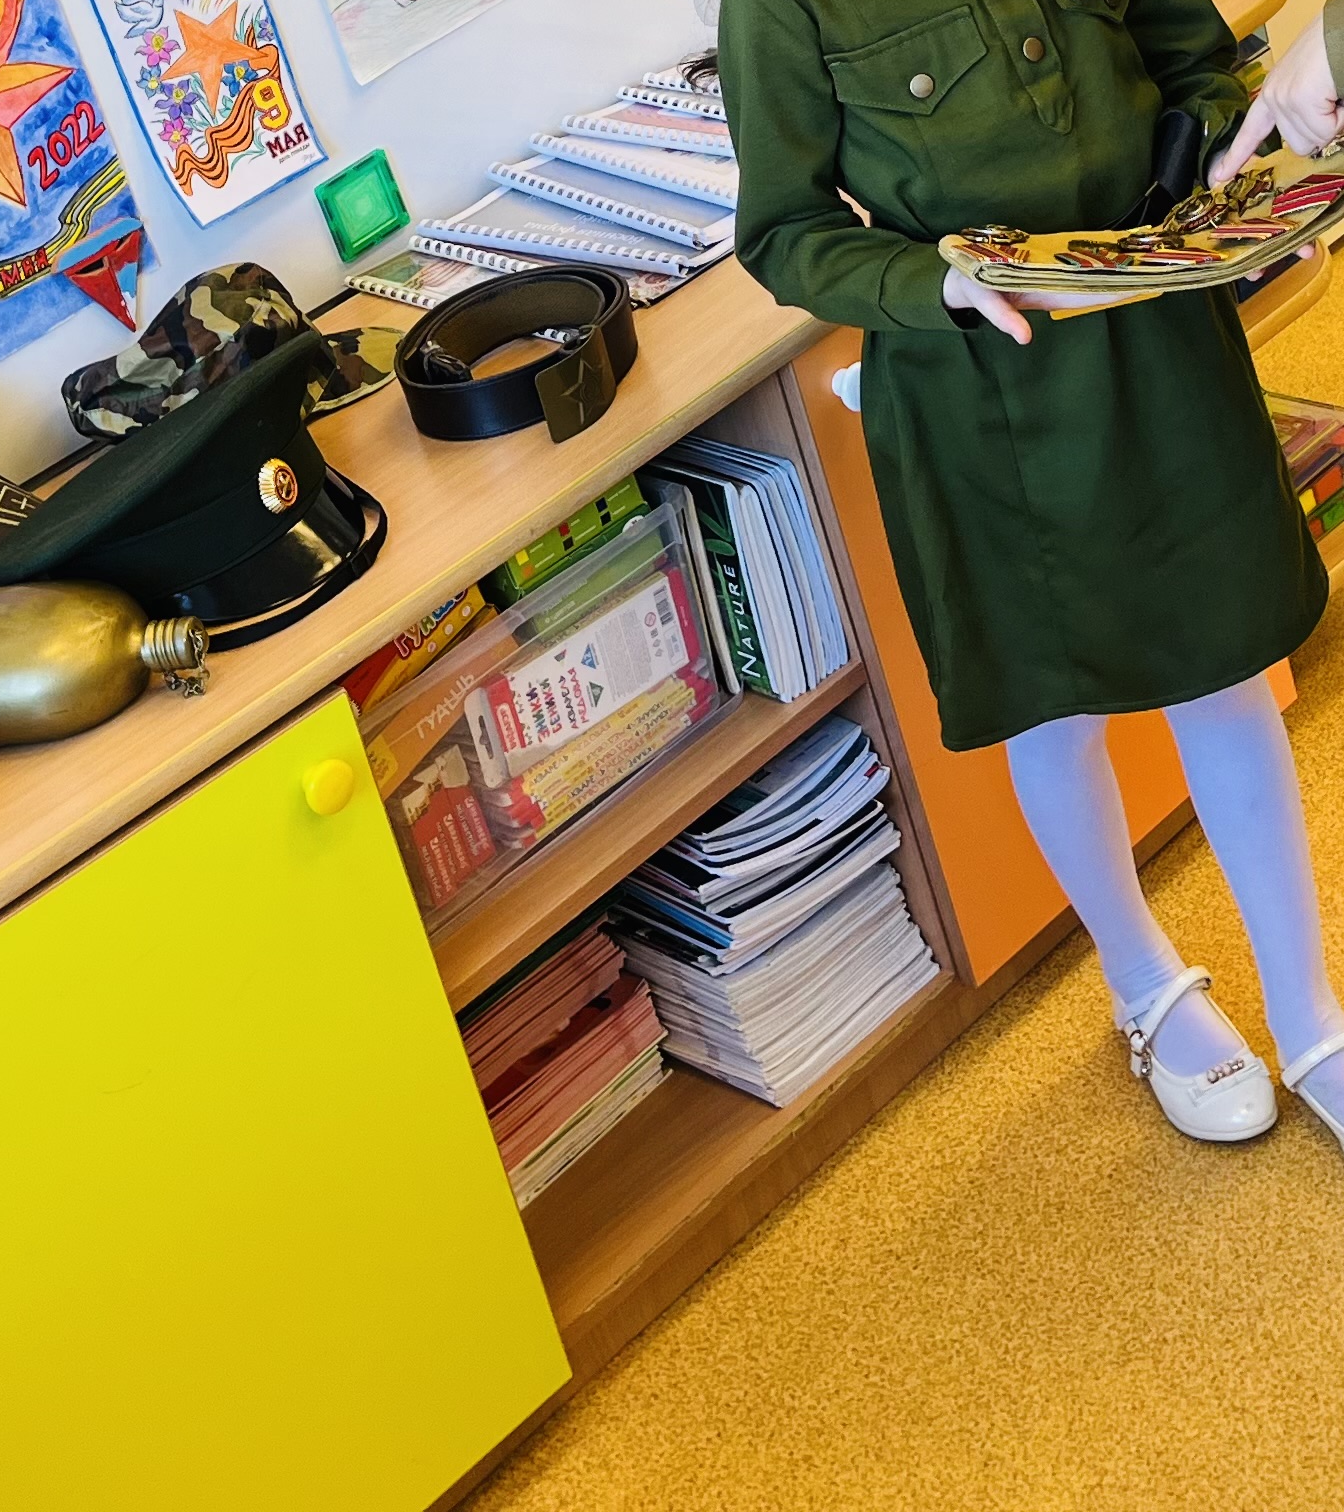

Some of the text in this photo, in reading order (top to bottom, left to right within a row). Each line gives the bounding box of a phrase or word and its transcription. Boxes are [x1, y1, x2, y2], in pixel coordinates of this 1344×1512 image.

[251, 76, 293, 133] 9
[28, 100, 106, 192] 2022
[265, 122, 310, 159] МАЯ
[723, 564, 761, 678] NATURE
[415, 674, 476, 740] ГУАШЬ
